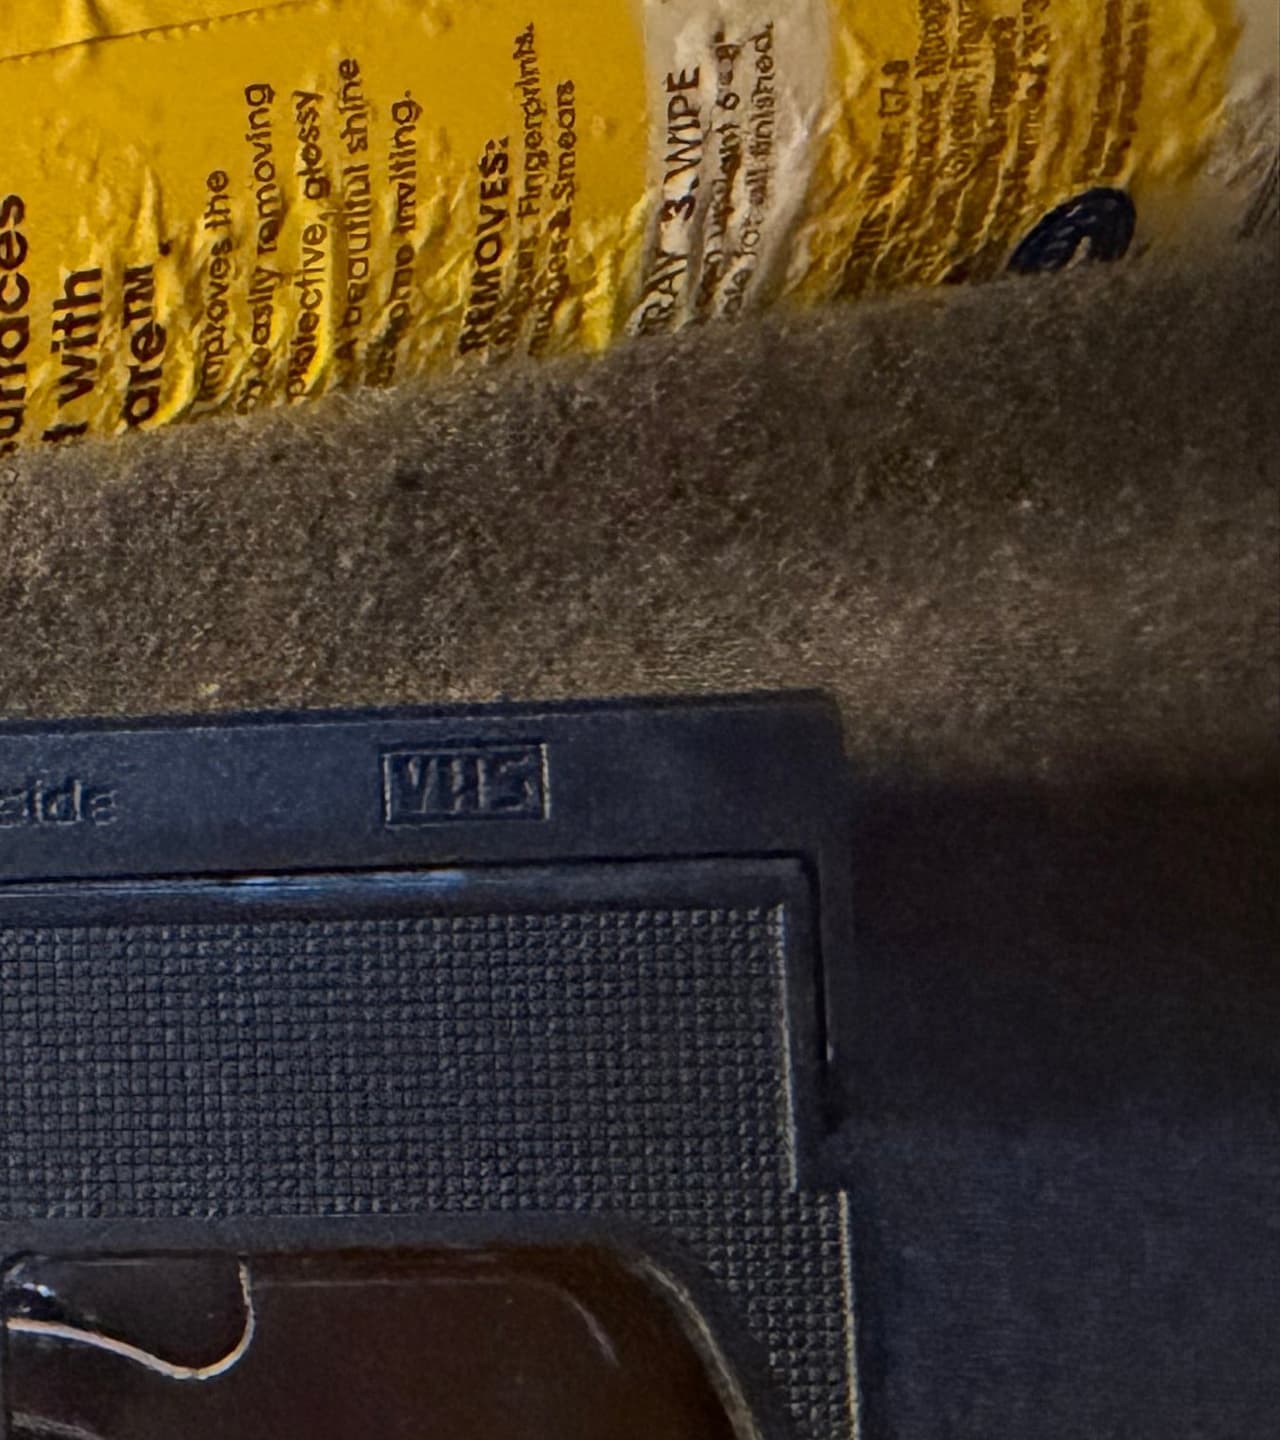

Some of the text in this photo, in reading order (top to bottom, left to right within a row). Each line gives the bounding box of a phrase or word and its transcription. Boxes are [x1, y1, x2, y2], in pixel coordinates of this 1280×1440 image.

[336, 57, 369, 156] shine
[203, 170, 232, 229] the
[244, 83, 282, 256] removing
[50, 268, 102, 408] with
[405, 753, 536, 815] VHS
